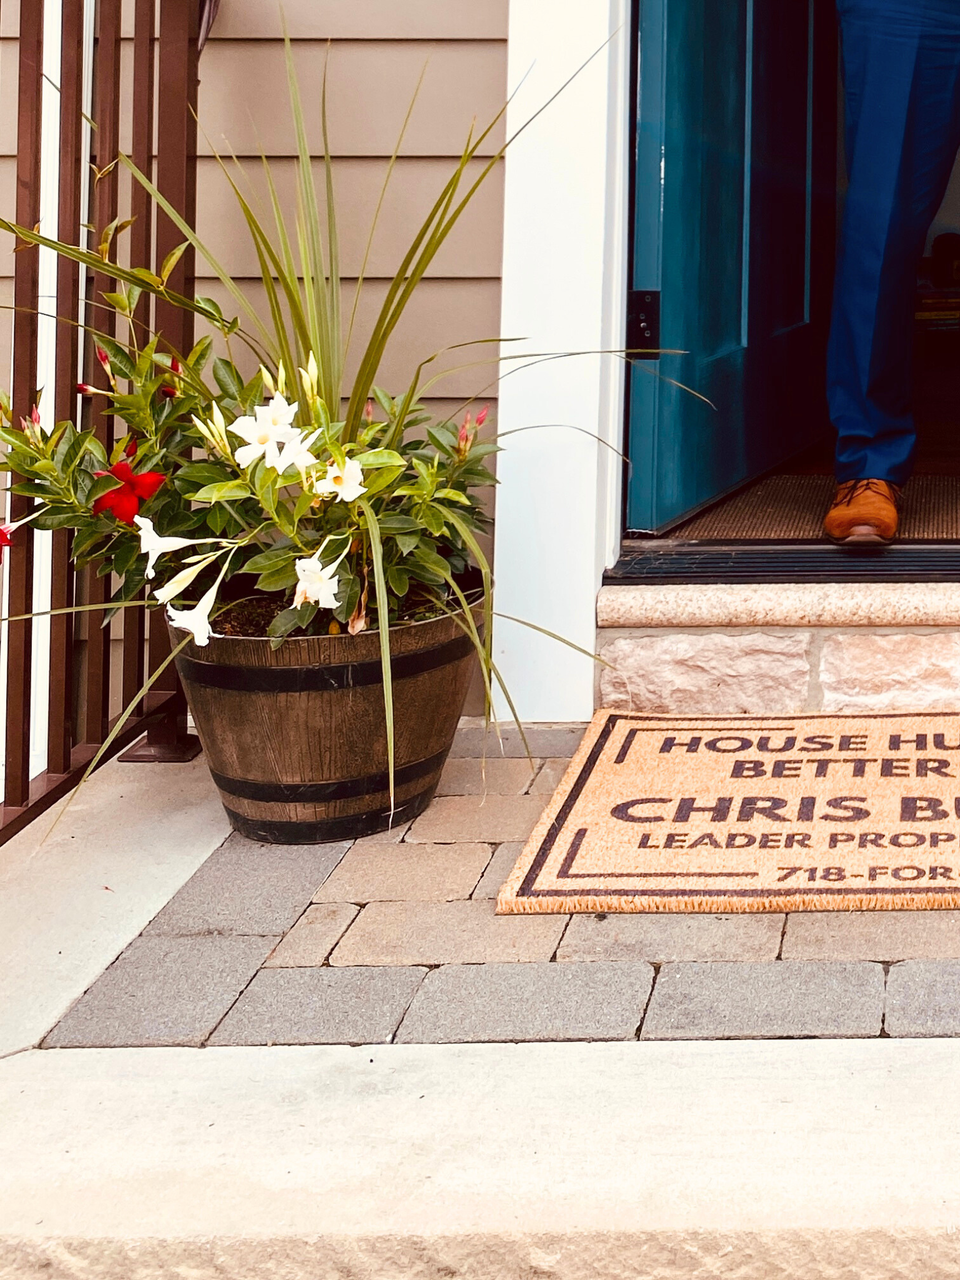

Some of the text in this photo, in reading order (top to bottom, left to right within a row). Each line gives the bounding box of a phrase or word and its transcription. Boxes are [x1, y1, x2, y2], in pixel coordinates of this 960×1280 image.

[659, 735, 868, 753] HOUSE
[730, 759, 955, 778] BETTER
[611, 797, 870, 823] CHRIS
[638, 833, 811, 848] LEADER
